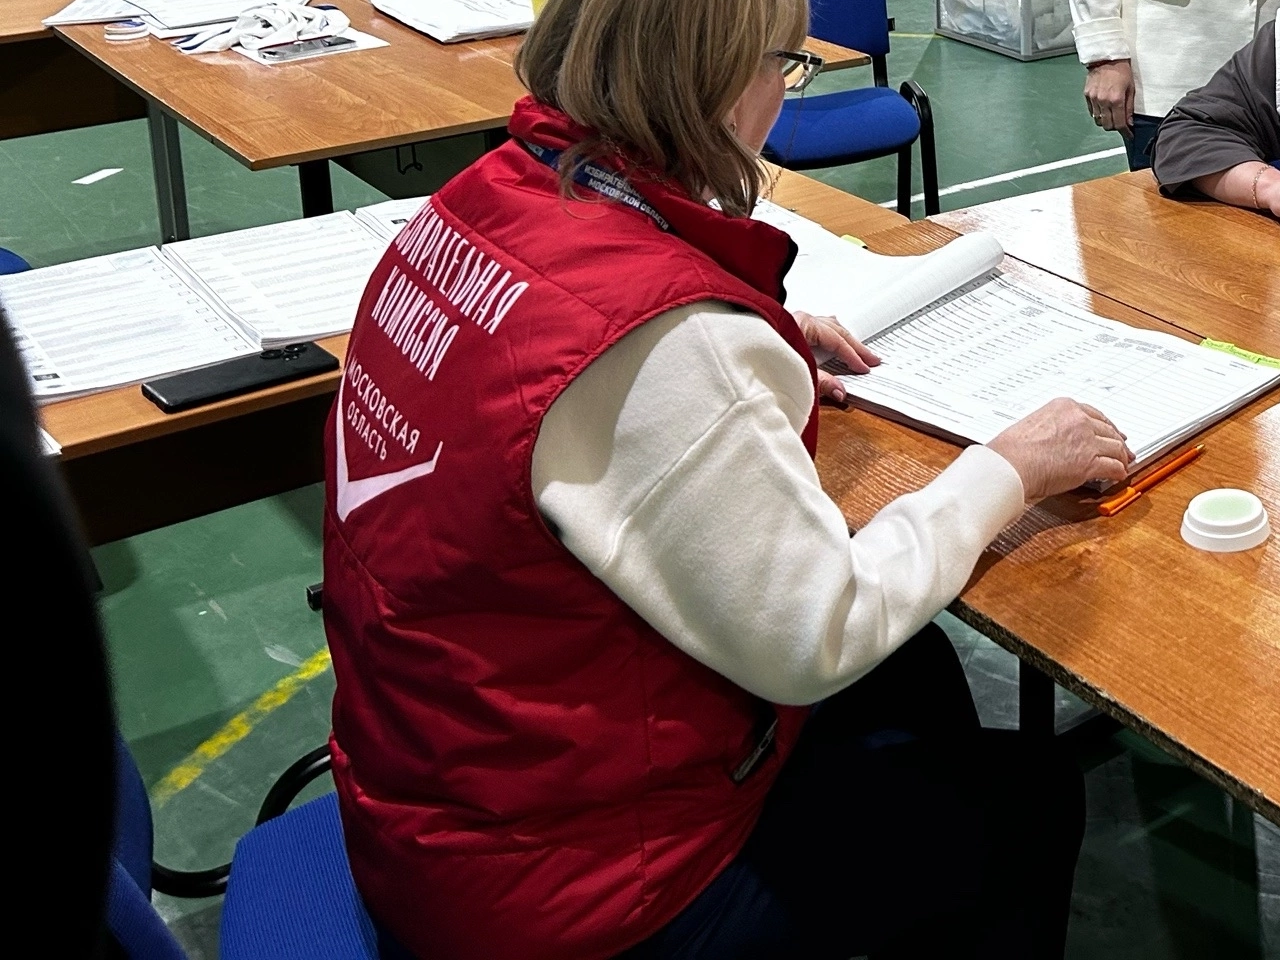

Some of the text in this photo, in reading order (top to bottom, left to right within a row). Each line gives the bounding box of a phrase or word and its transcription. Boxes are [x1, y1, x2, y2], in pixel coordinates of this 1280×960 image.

[371, 265, 460, 381] КОМИССИЯ
[347, 354, 420, 455] МОСКОВСКАЯ
[347, 401, 387, 460] ОБЛАСТЬ
